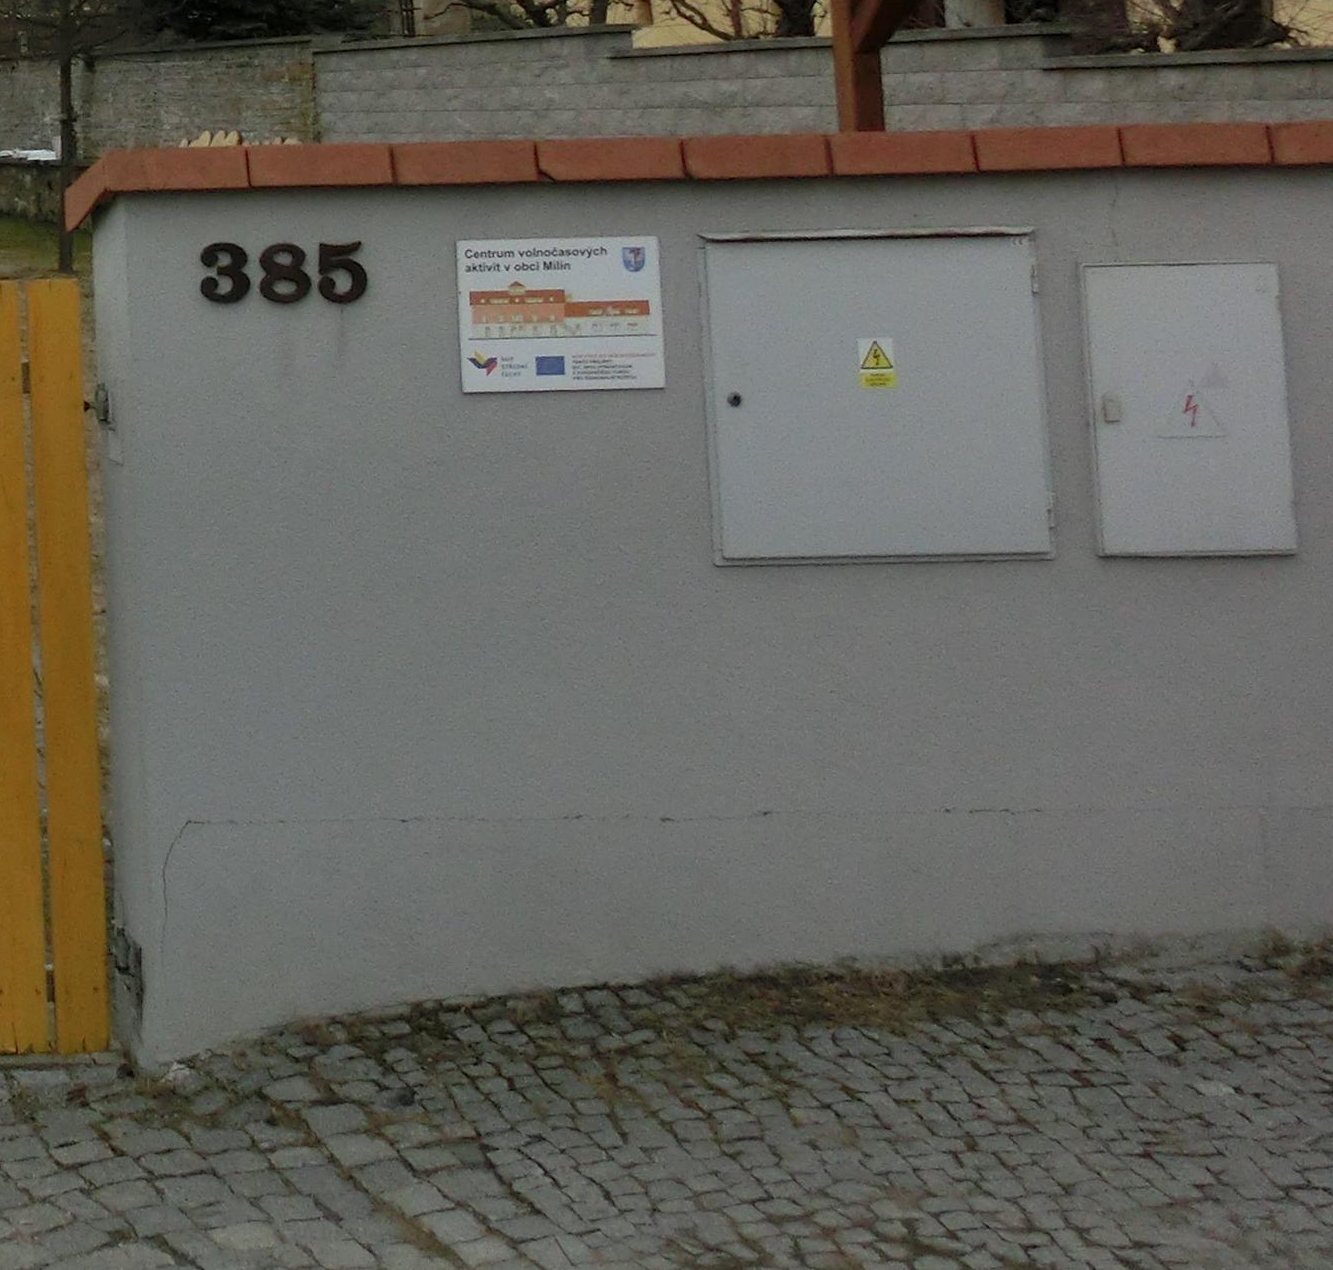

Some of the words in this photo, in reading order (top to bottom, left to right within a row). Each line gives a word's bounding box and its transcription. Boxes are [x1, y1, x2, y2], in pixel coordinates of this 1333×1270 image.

[464, 248, 515, 260] Centrum
[518, 246, 608, 260] volnočasových
[200, 241, 368, 305] 385
[465, 262, 501, 273] aktivit
[504, 264, 511, 272] v
[513, 261, 540, 272] obci
